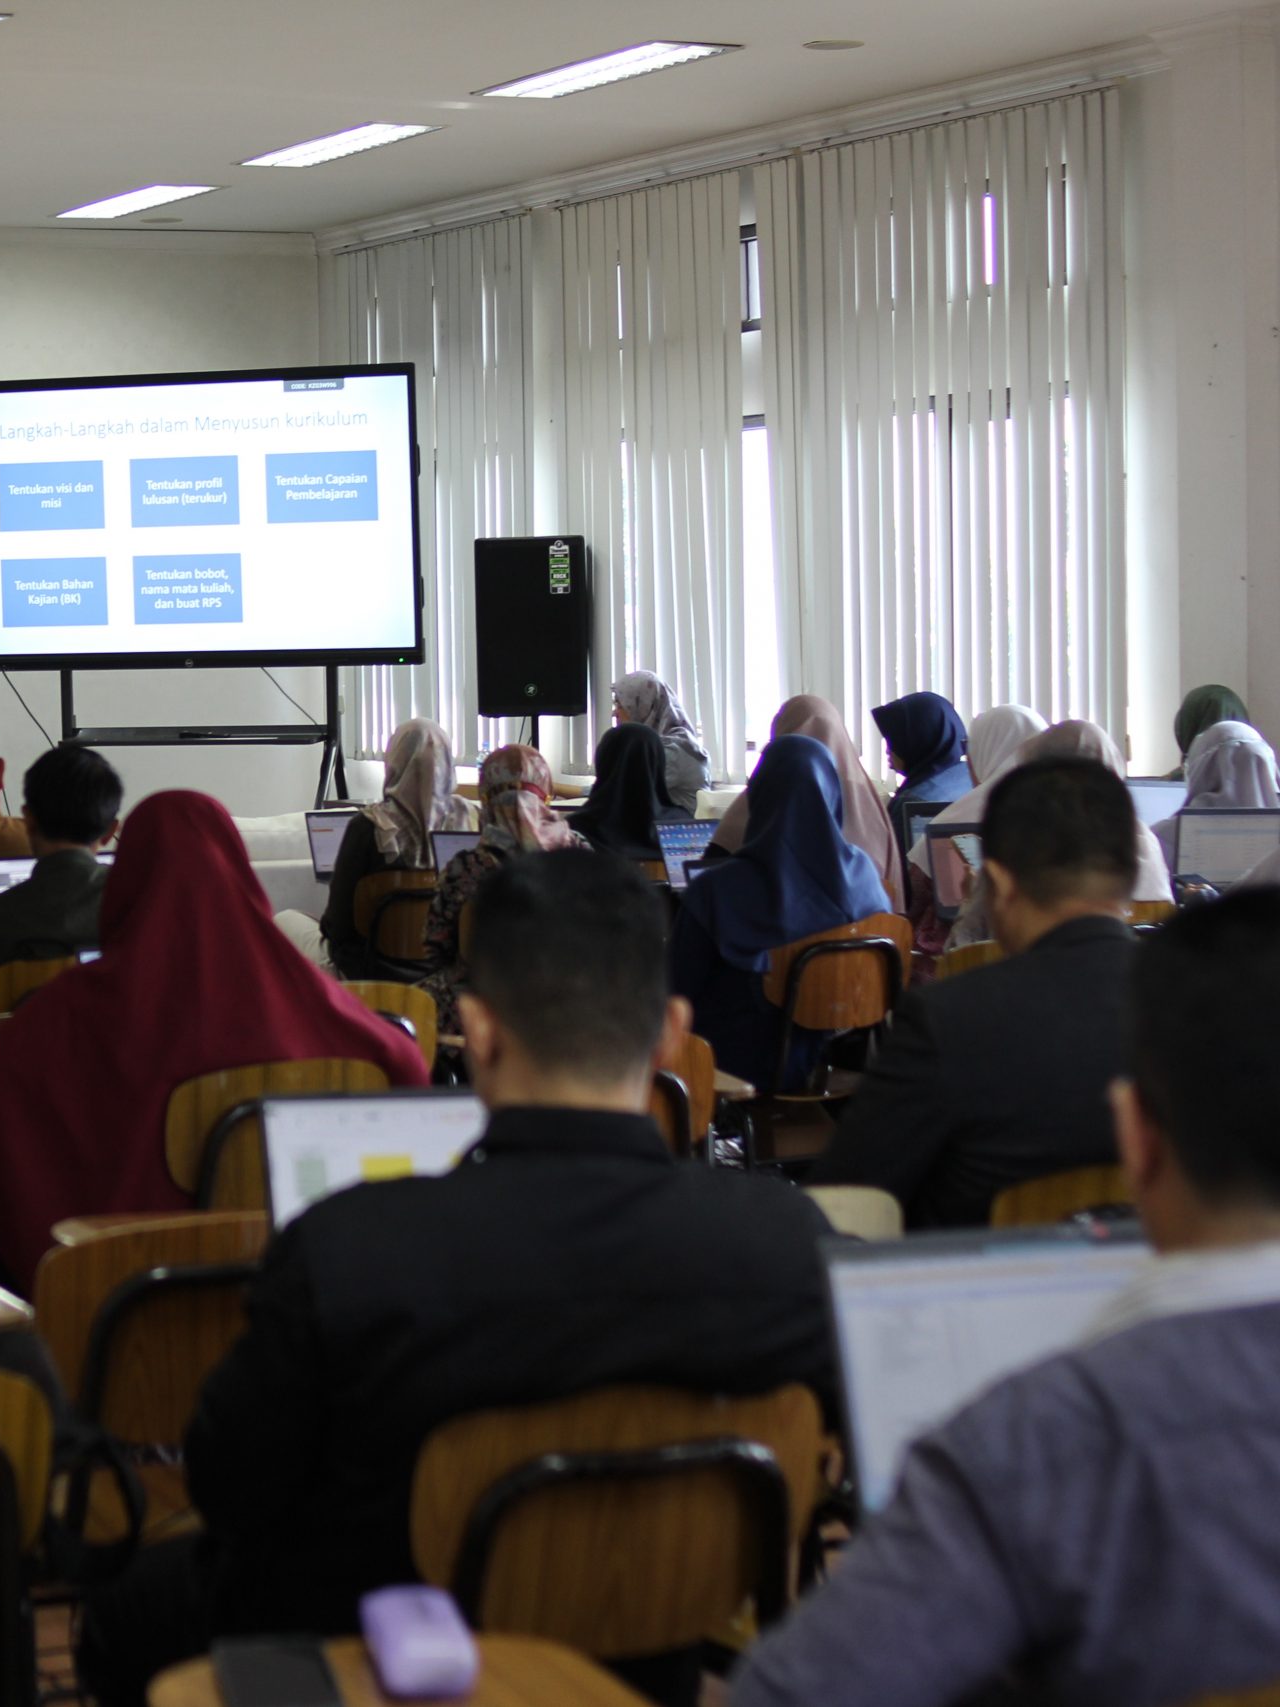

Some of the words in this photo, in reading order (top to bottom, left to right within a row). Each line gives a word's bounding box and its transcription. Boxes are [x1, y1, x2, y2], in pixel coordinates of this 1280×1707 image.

[0, 418, 135, 442] Langkah-Langkah
[140, 416, 189, 434] dalam
[195, 414, 280, 434] Menyusun
[285, 410, 368, 428] kurikulum
[145, 478, 193, 490] Tentukan
[194, 477, 223, 491] profil
[274, 474, 323, 486] Tentukan
[325, 473, 368, 486] Capaian
[7, 483, 54, 495] Tentukan
[55, 482, 73, 494] visi
[74, 482, 94, 493] dan
[285, 488, 358, 501] Pembelajaran
[40, 498, 62, 508] misi
[142, 494, 179, 505] lulusan
[181, 491, 228, 506] (terukur)
[145, 568, 193, 580] Tentukan
[194, 567, 229, 580] bobot,
[14, 580, 60, 591] Tentukan
[61, 579, 94, 590] Bahan
[141, 586, 170, 595] nama
[171, 584, 199, 594] mata
[200, 582, 235, 595] kuliah,
[27, 594, 59, 607] Kajian
[60, 592, 81, 606] (BK)
[154, 598, 174, 609] dan
[176, 598, 200, 609] buat
[202, 597, 222, 608] RPS
